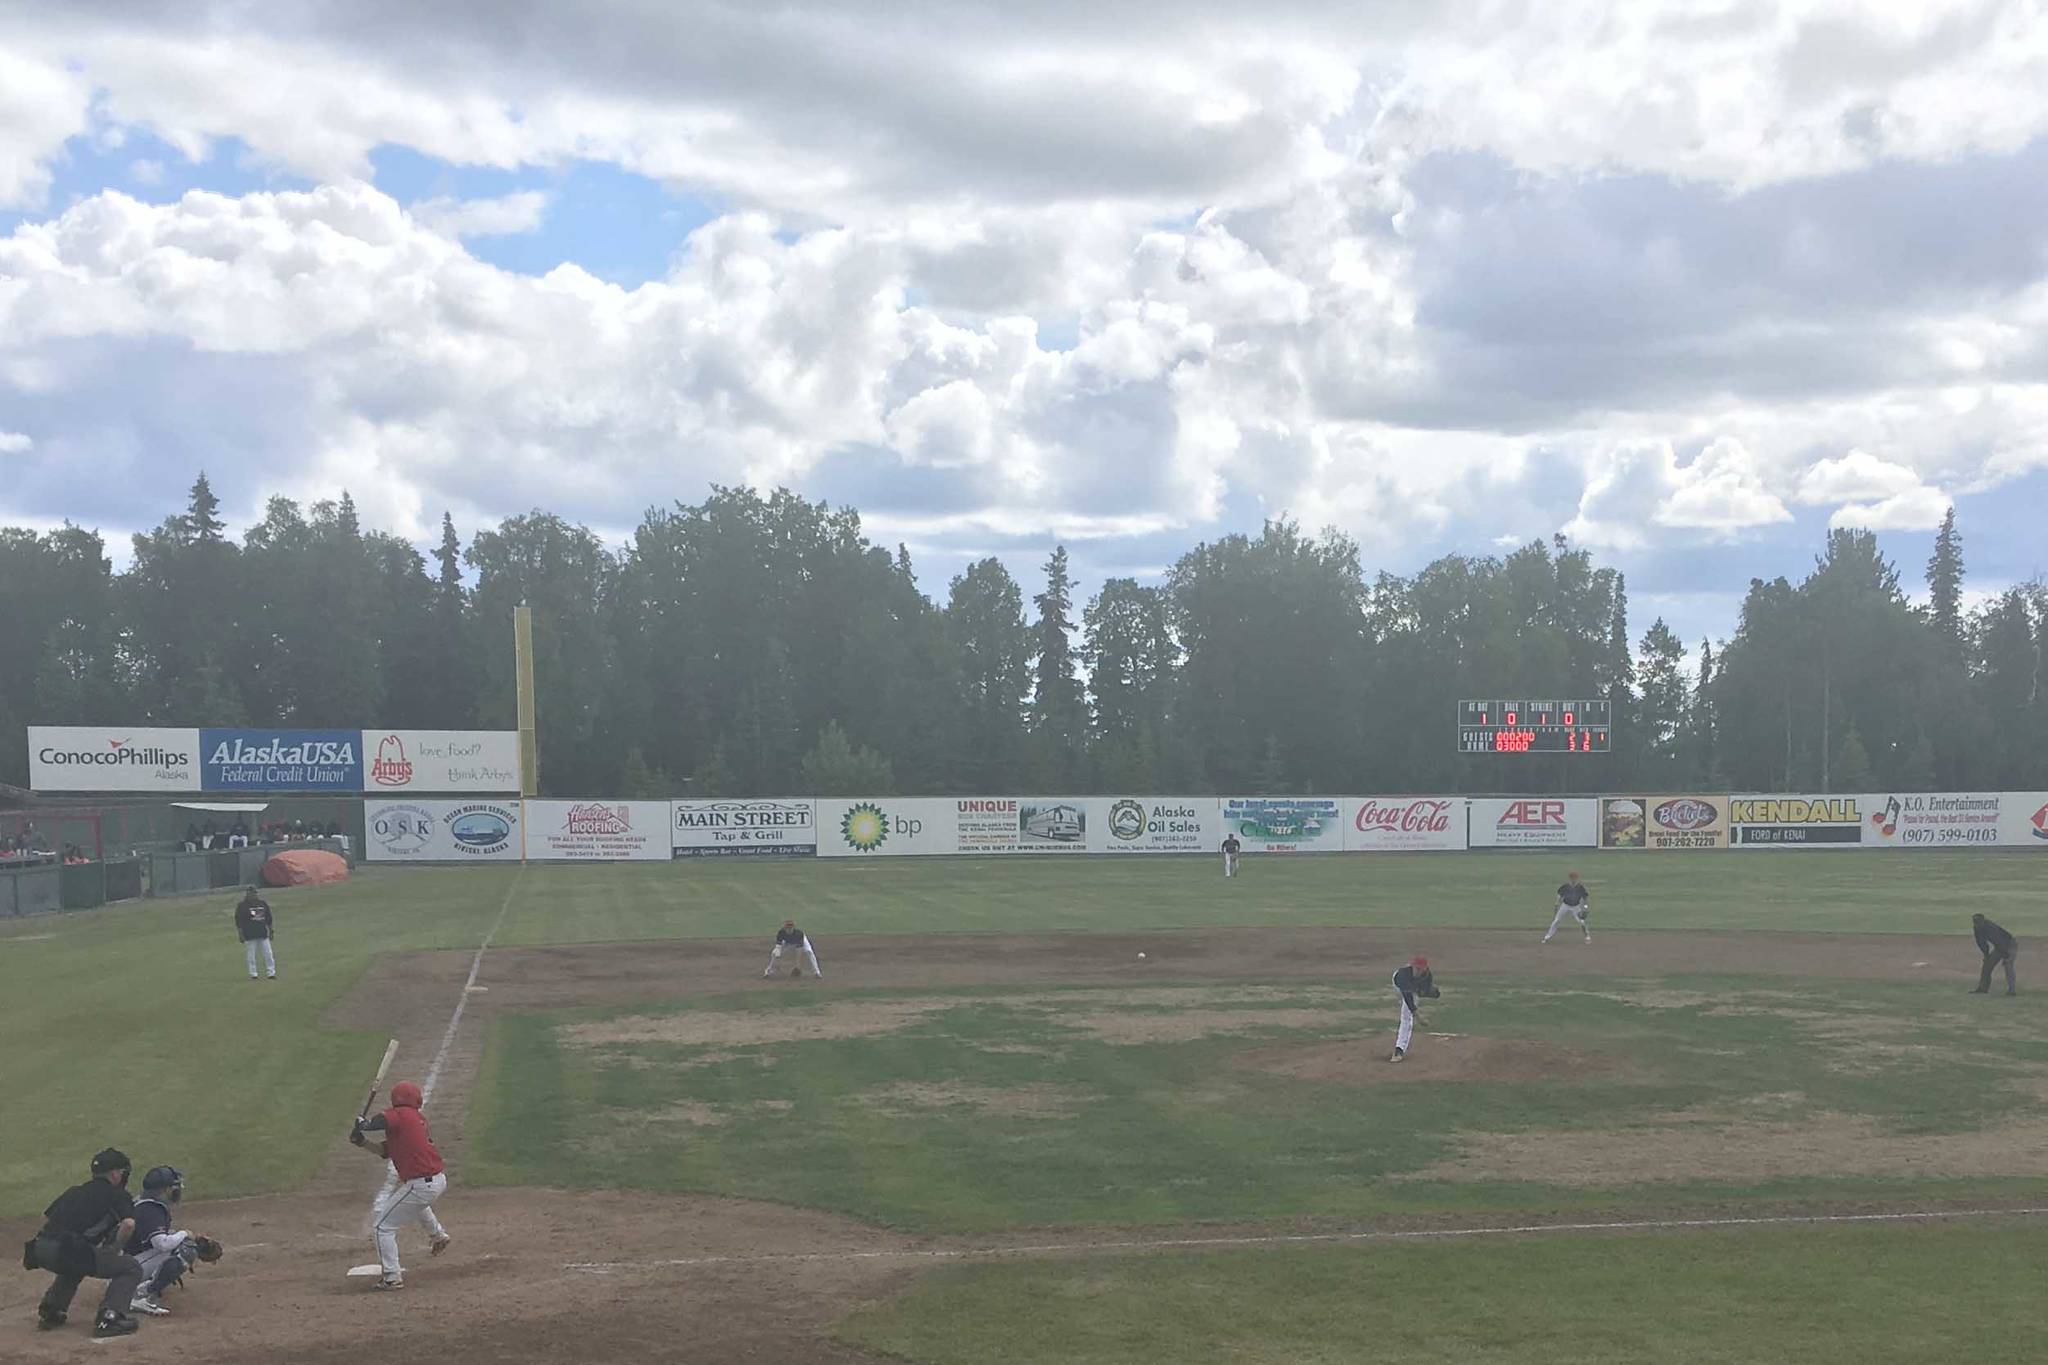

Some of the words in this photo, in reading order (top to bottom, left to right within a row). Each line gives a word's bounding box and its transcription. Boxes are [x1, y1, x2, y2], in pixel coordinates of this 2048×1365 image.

[39, 748, 188, 769] ConocoPhillips
[208, 738, 355, 765] AlaskaUSA
[154, 769, 188, 780] Alaska
[221, 766, 263, 783] Federal
[266, 766, 303, 783] Credit
[957, 800, 1017, 813] UNIQUE
[1903, 797, 1925, 811] K.O.
[1929, 795, 1999, 811] Entertainment
[1152, 805, 1195, 818] Alaska
[1497, 800, 1566, 824] AER
[1730, 799, 1861, 823] KENDALL
[679, 813, 728, 827] MAIN
[734, 811, 809, 826] STREET
[895, 815, 922, 838] bp
[1147, 820, 1165, 833] Oil
[1169, 820, 1201, 833] Sales
[570, 821, 621, 834] ROOFING
[1751, 829, 1771, 840] FORD
[1773, 829, 1781, 840] of
[1784, 829, 1806, 840] KENAI
[712, 831, 736, 842] Tap
[740, 831, 751, 840] &
[755, 830, 783, 840] Grill
[1902, 828, 1935, 843] (907)
[1937, 828, 1997, 842] 599-0103
